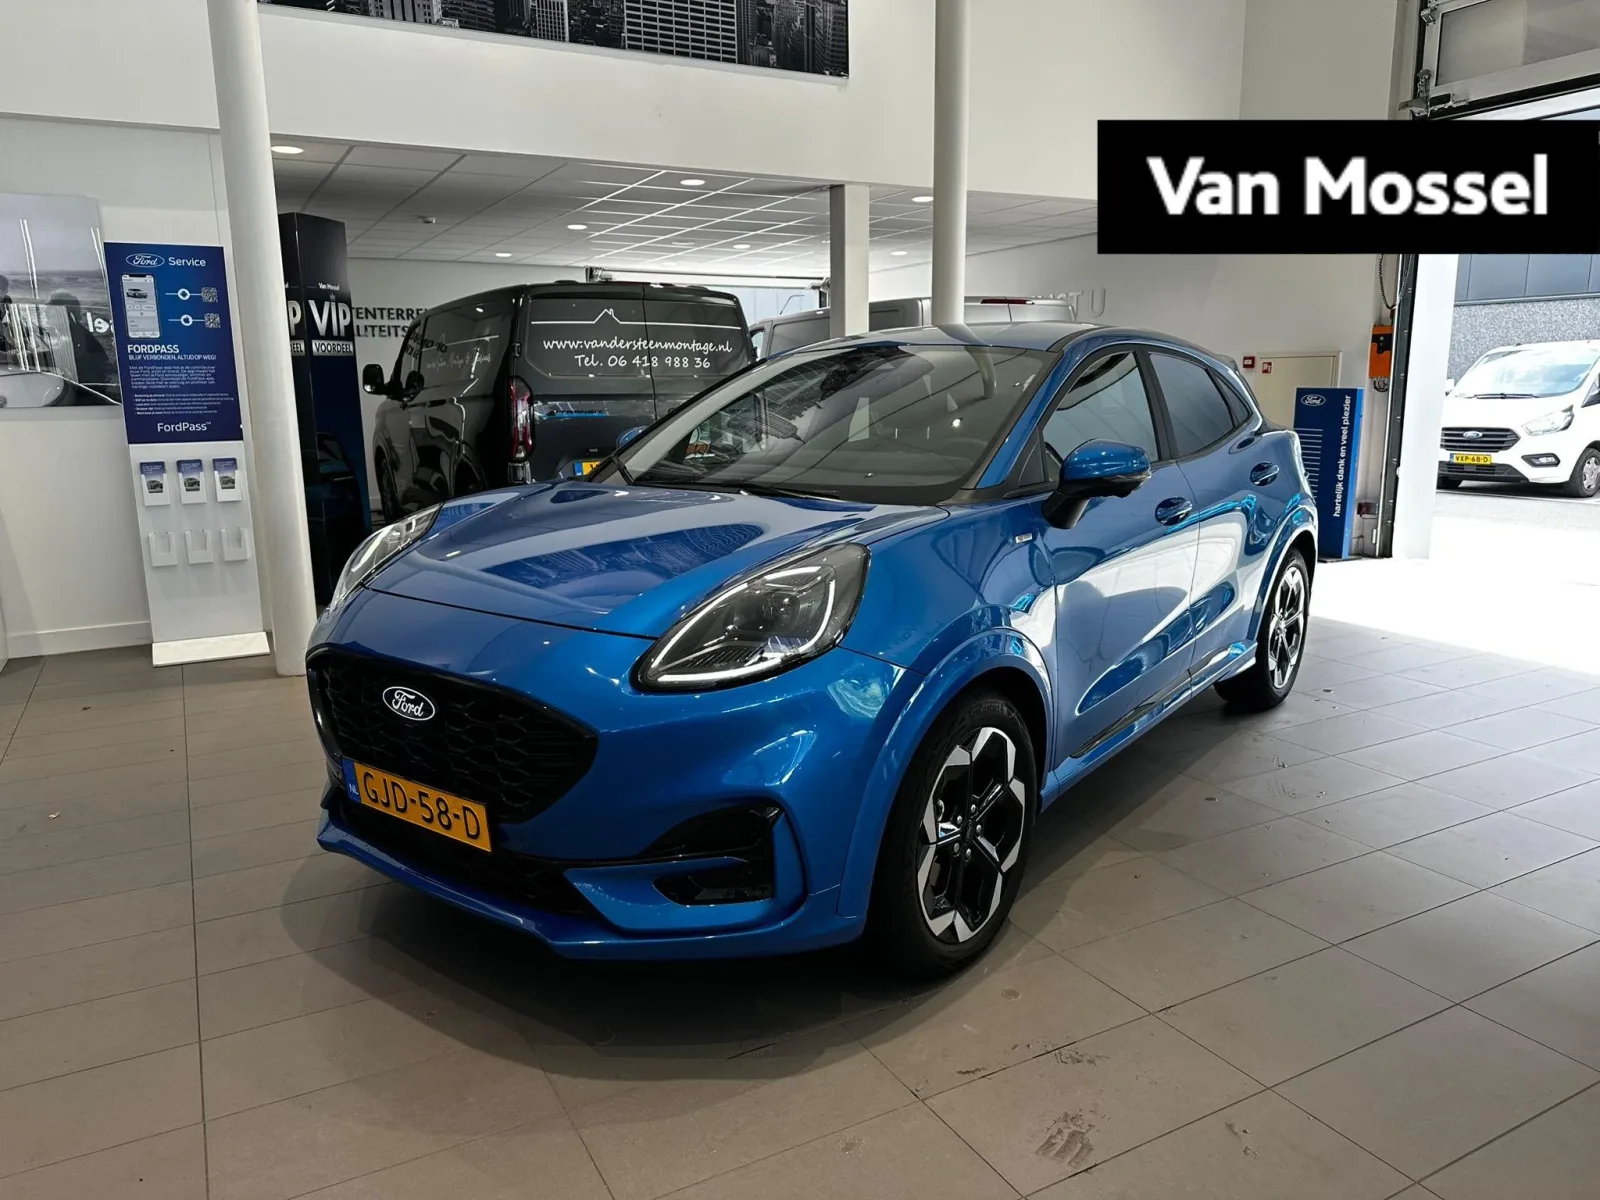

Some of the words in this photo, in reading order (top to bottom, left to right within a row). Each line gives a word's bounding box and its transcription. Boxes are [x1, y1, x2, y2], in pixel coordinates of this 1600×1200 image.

[168, 257, 206, 267] Service
[127, 344, 180, 354] FORDPASS
[314, 342, 353, 354] VOORDEEL
[543, 336, 732, 354] www.vandersteenmontage.nl
[574, 354, 603, 367] Tel.
[607, 355, 626, 367] 06
[632, 355, 659, 368] 418
[664, 355, 690, 368] 988
[694, 357, 711, 369] 36
[1342, 395, 1351, 425] plezier
[1341, 426, 1349, 445] veel
[1340, 447, 1346, 457] en
[1337, 458, 1346, 480] dank
[1333, 481, 1344, 517] hartelijk
[363, 771, 481, 840] GJD-58-D
